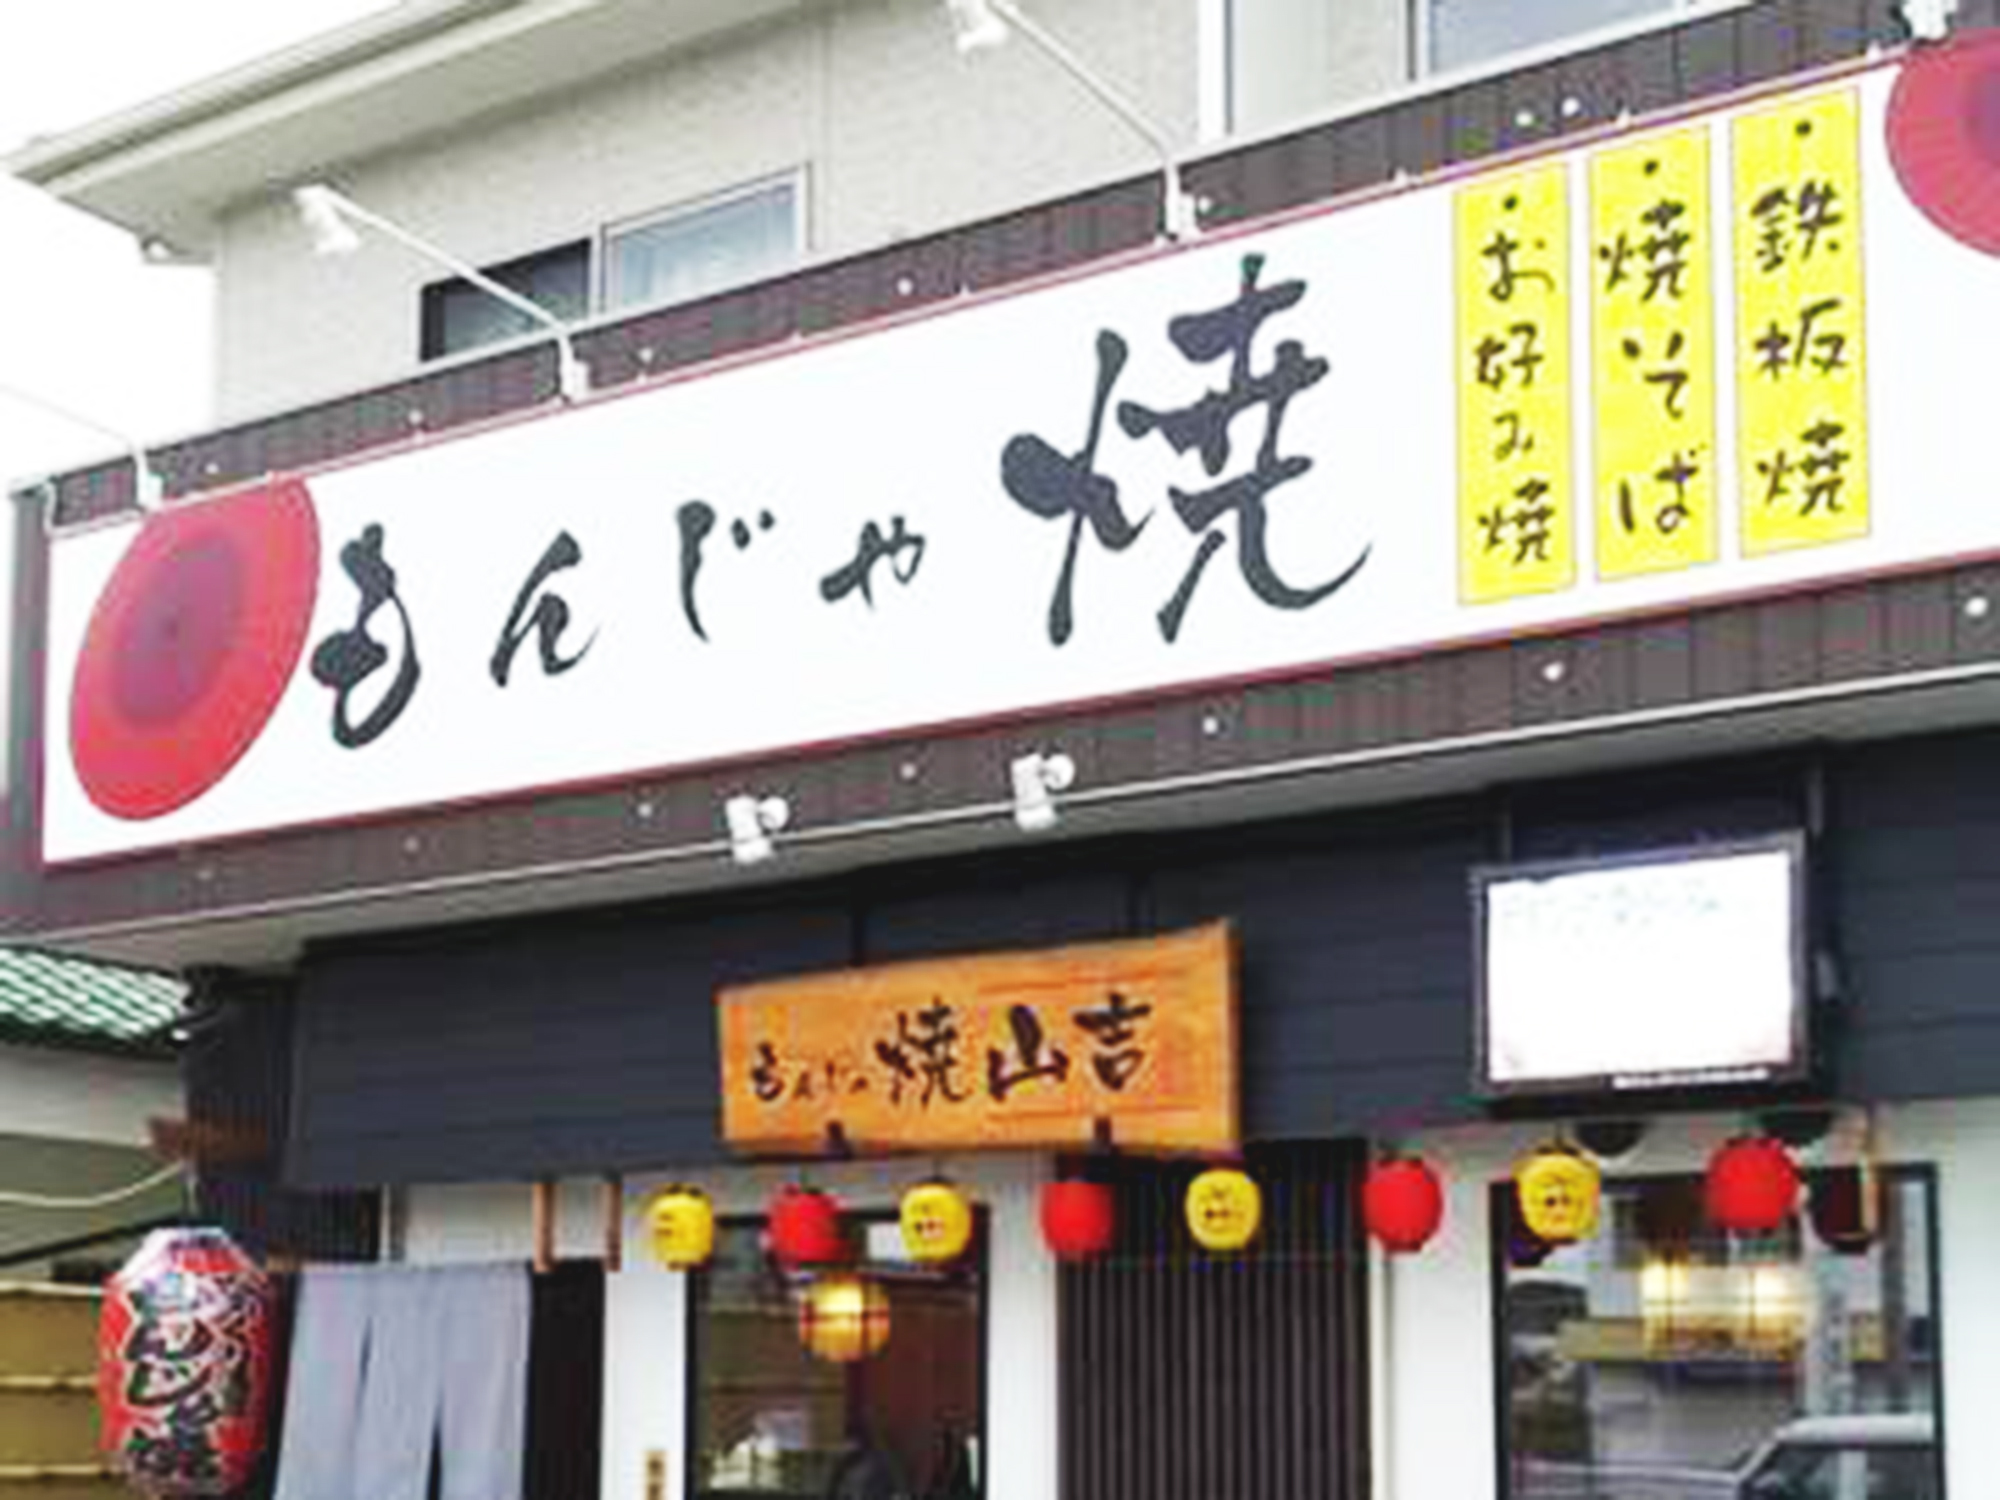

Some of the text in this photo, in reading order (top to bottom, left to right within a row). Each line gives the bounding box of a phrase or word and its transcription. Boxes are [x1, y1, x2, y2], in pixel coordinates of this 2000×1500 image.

[311, 253, 1372, 748] もんじゃ焼
[1475, 231, 1556, 565] お好み焼
[1750, 180, 1850, 517] 鉄板焼
